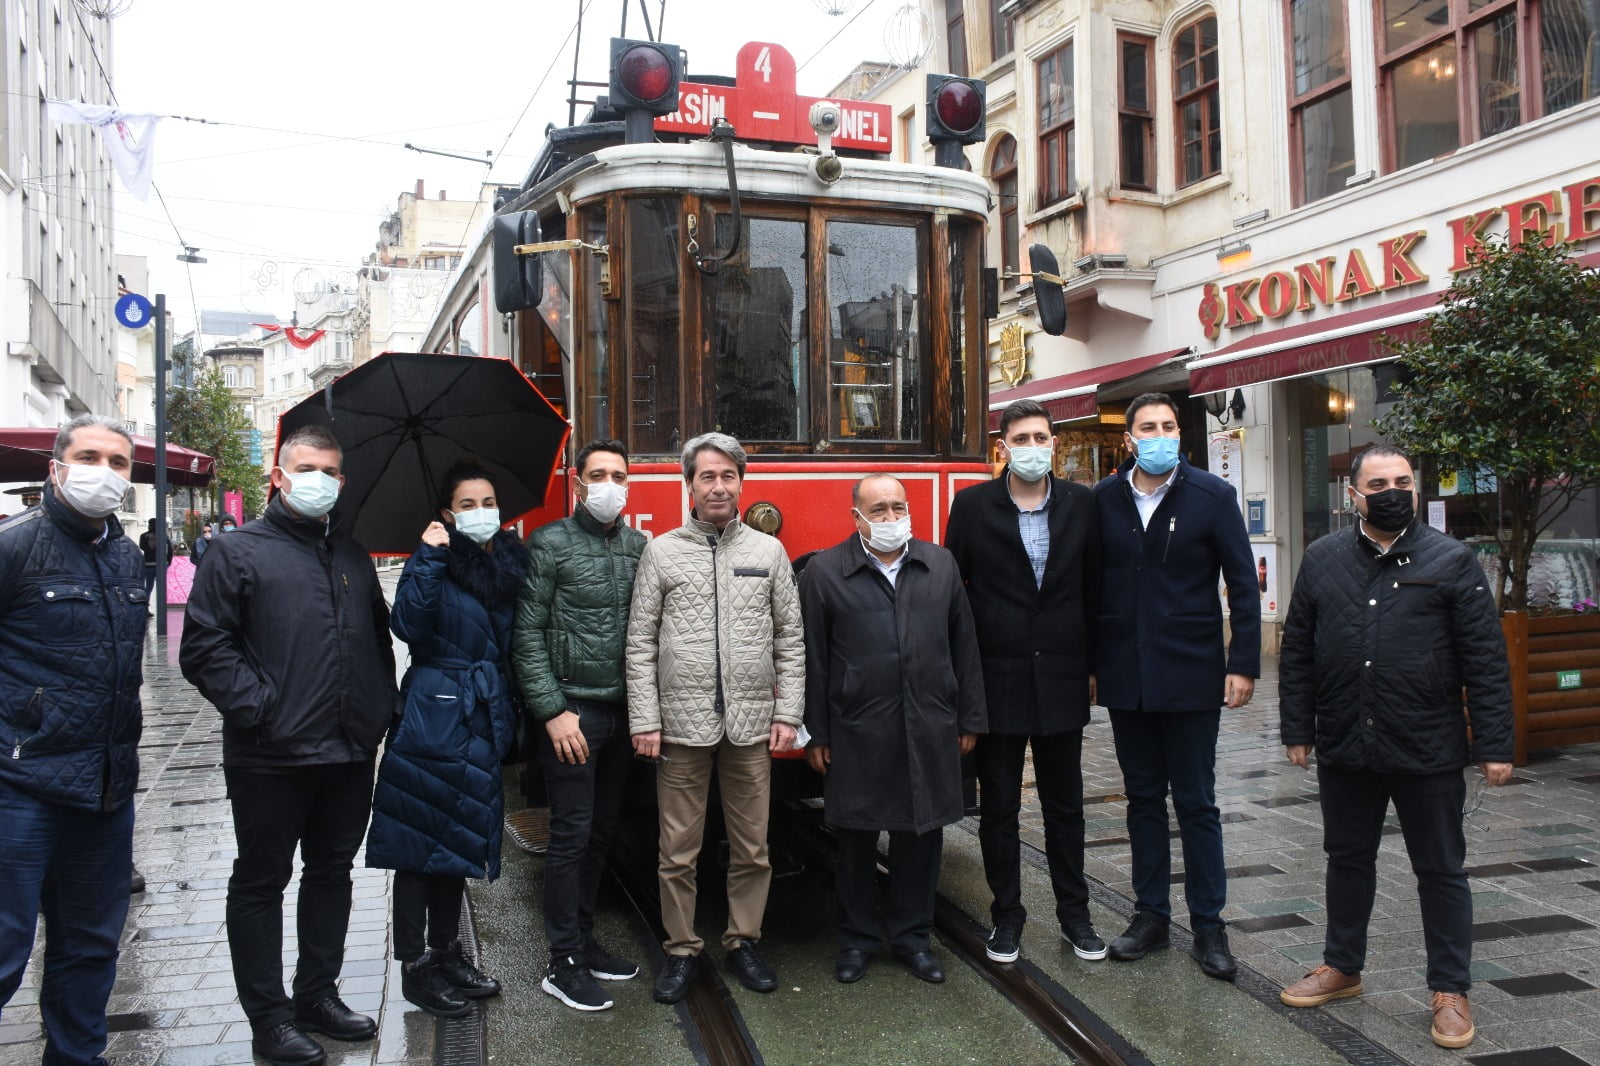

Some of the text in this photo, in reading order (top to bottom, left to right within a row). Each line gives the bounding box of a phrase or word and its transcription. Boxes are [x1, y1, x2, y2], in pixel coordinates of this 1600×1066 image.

[754, 46, 772, 82] 4
[1223, 229, 1429, 329] KONAK
[1225, 357, 1284, 386] BEYOĞLU
[1298, 344, 1351, 373] KONAK
